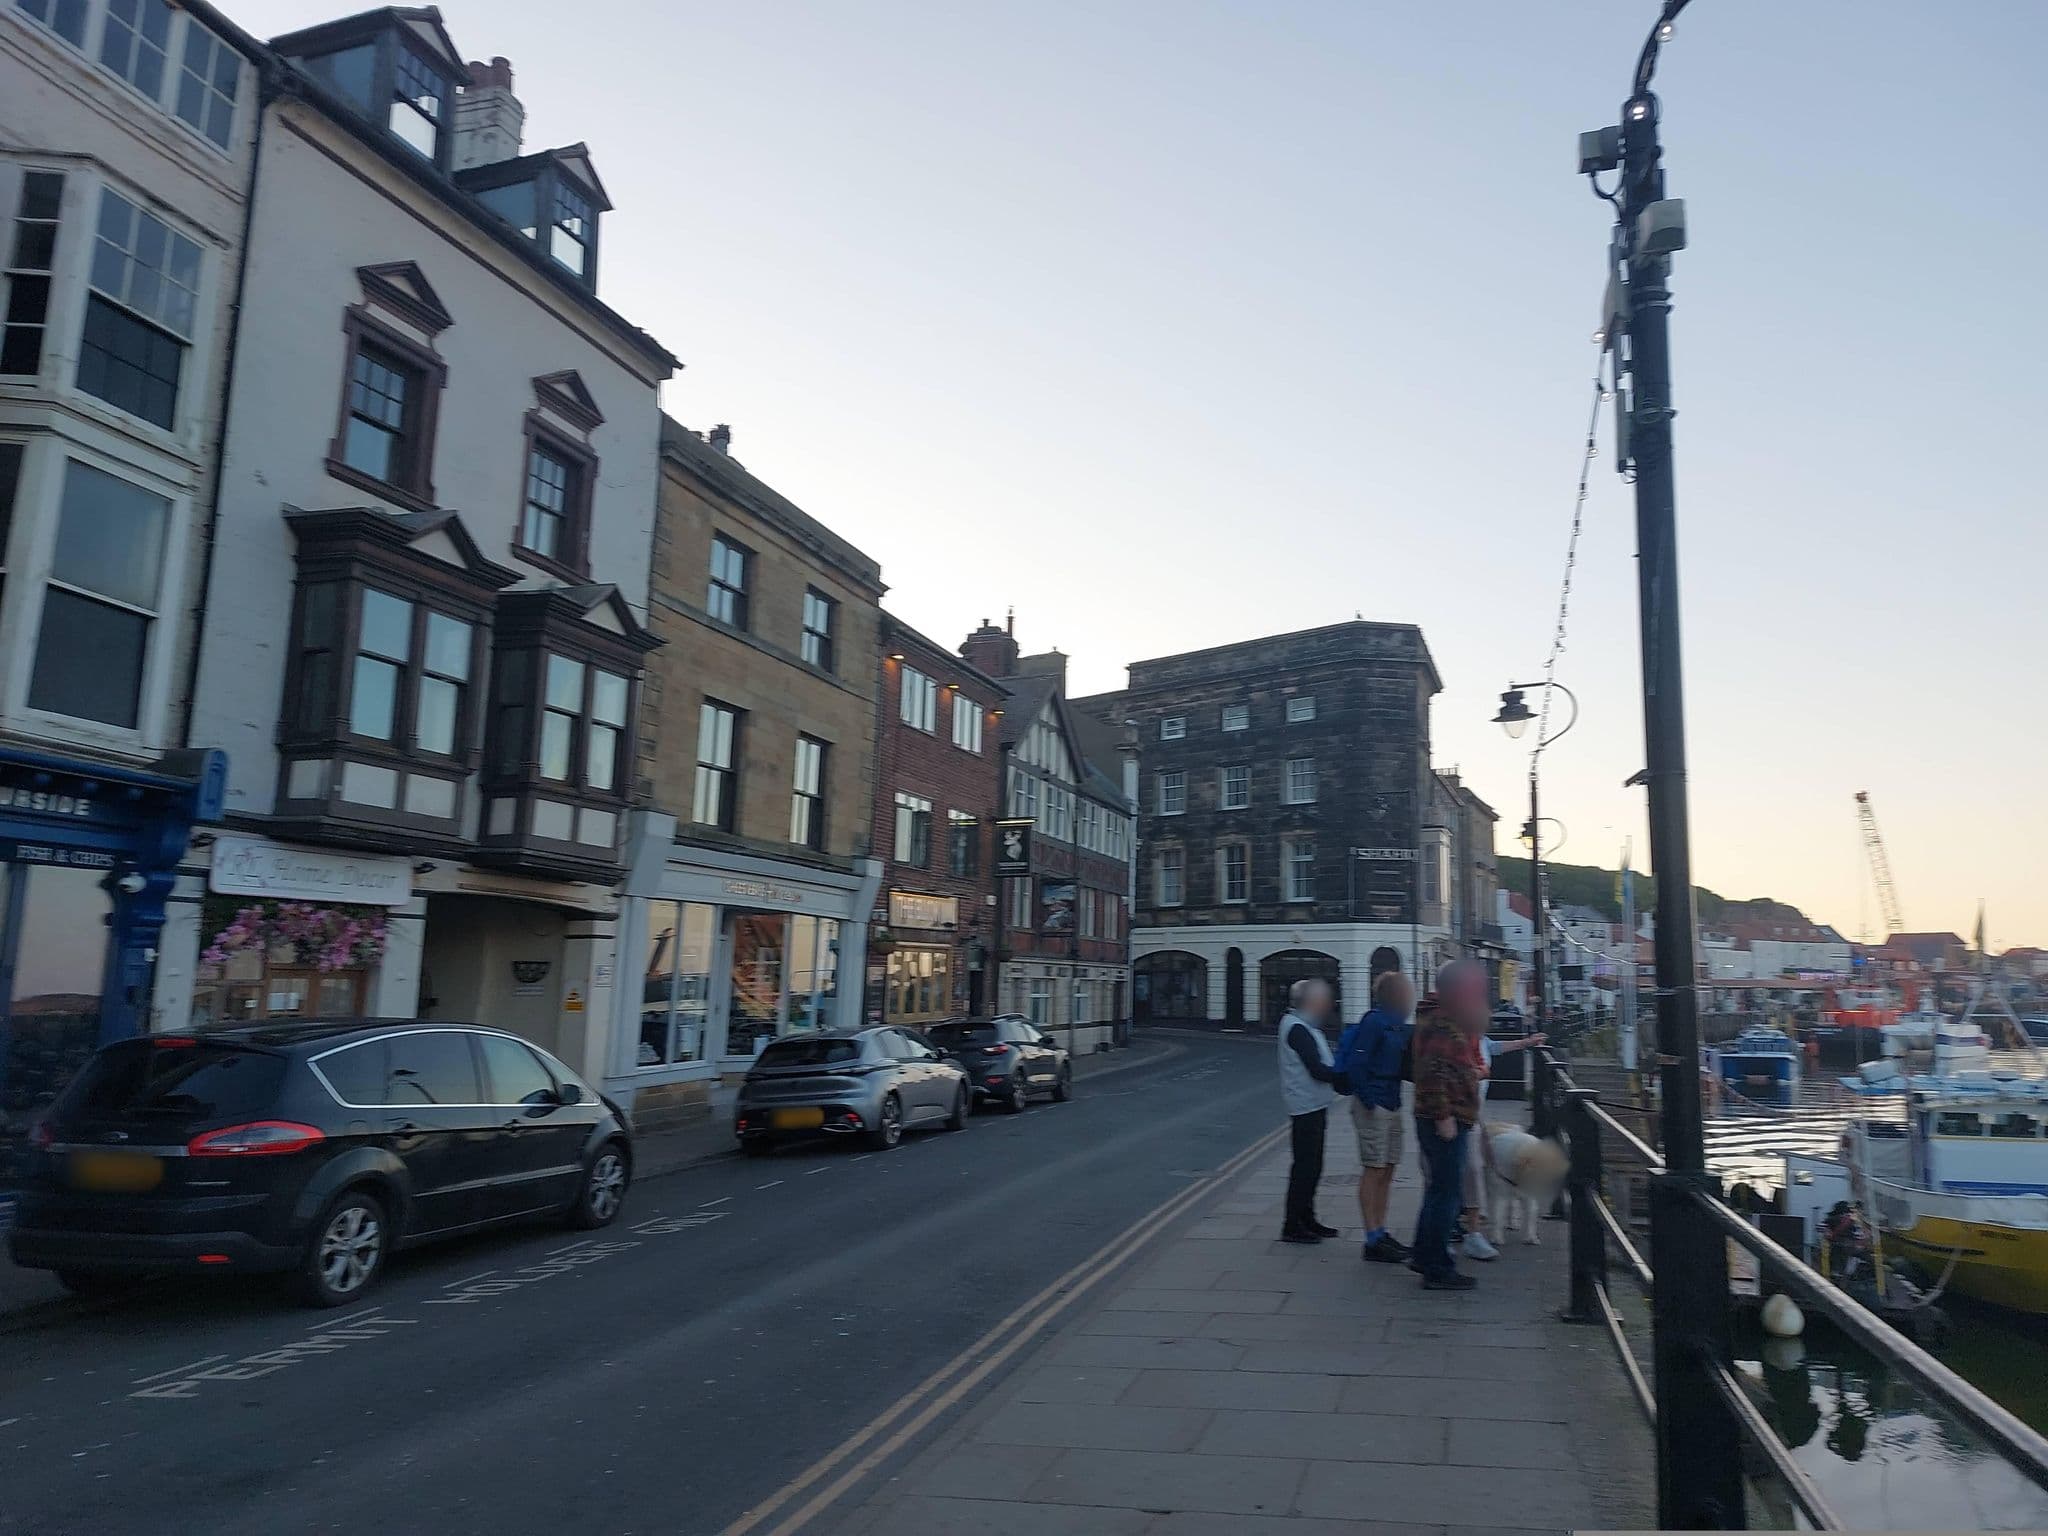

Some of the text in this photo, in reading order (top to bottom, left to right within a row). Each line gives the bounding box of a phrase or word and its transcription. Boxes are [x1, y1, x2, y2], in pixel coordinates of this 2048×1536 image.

[16, 845, 115, 867] FISH & CHIPS
[130, 1212, 732, 1398] PERMIT HOLDERS ONLY
